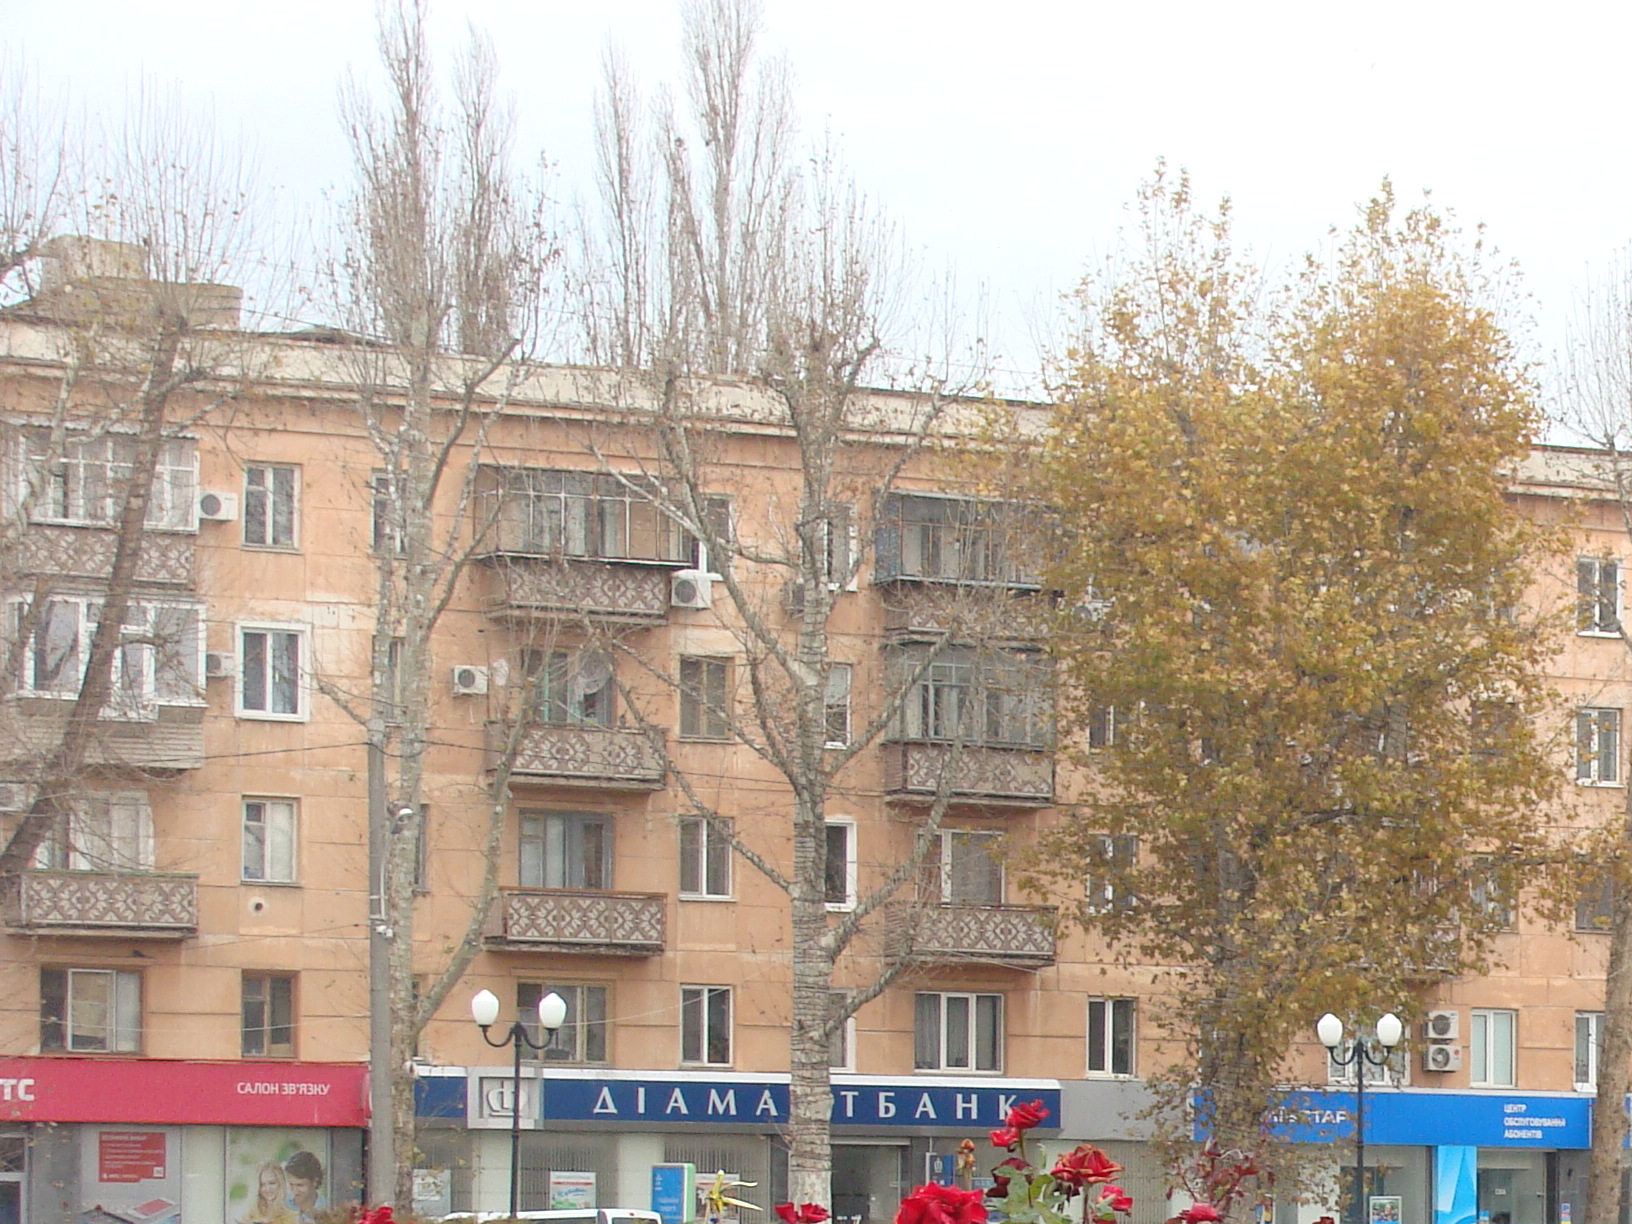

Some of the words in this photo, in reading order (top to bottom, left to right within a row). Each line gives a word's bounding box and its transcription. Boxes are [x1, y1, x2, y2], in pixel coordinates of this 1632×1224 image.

[237, 1082, 279, 1094] САЛОН
[281, 1082, 330, 1096] ЗВ'ЯЗКУ
[593, 1086, 1018, 1120] ДІАМАТБАНК
